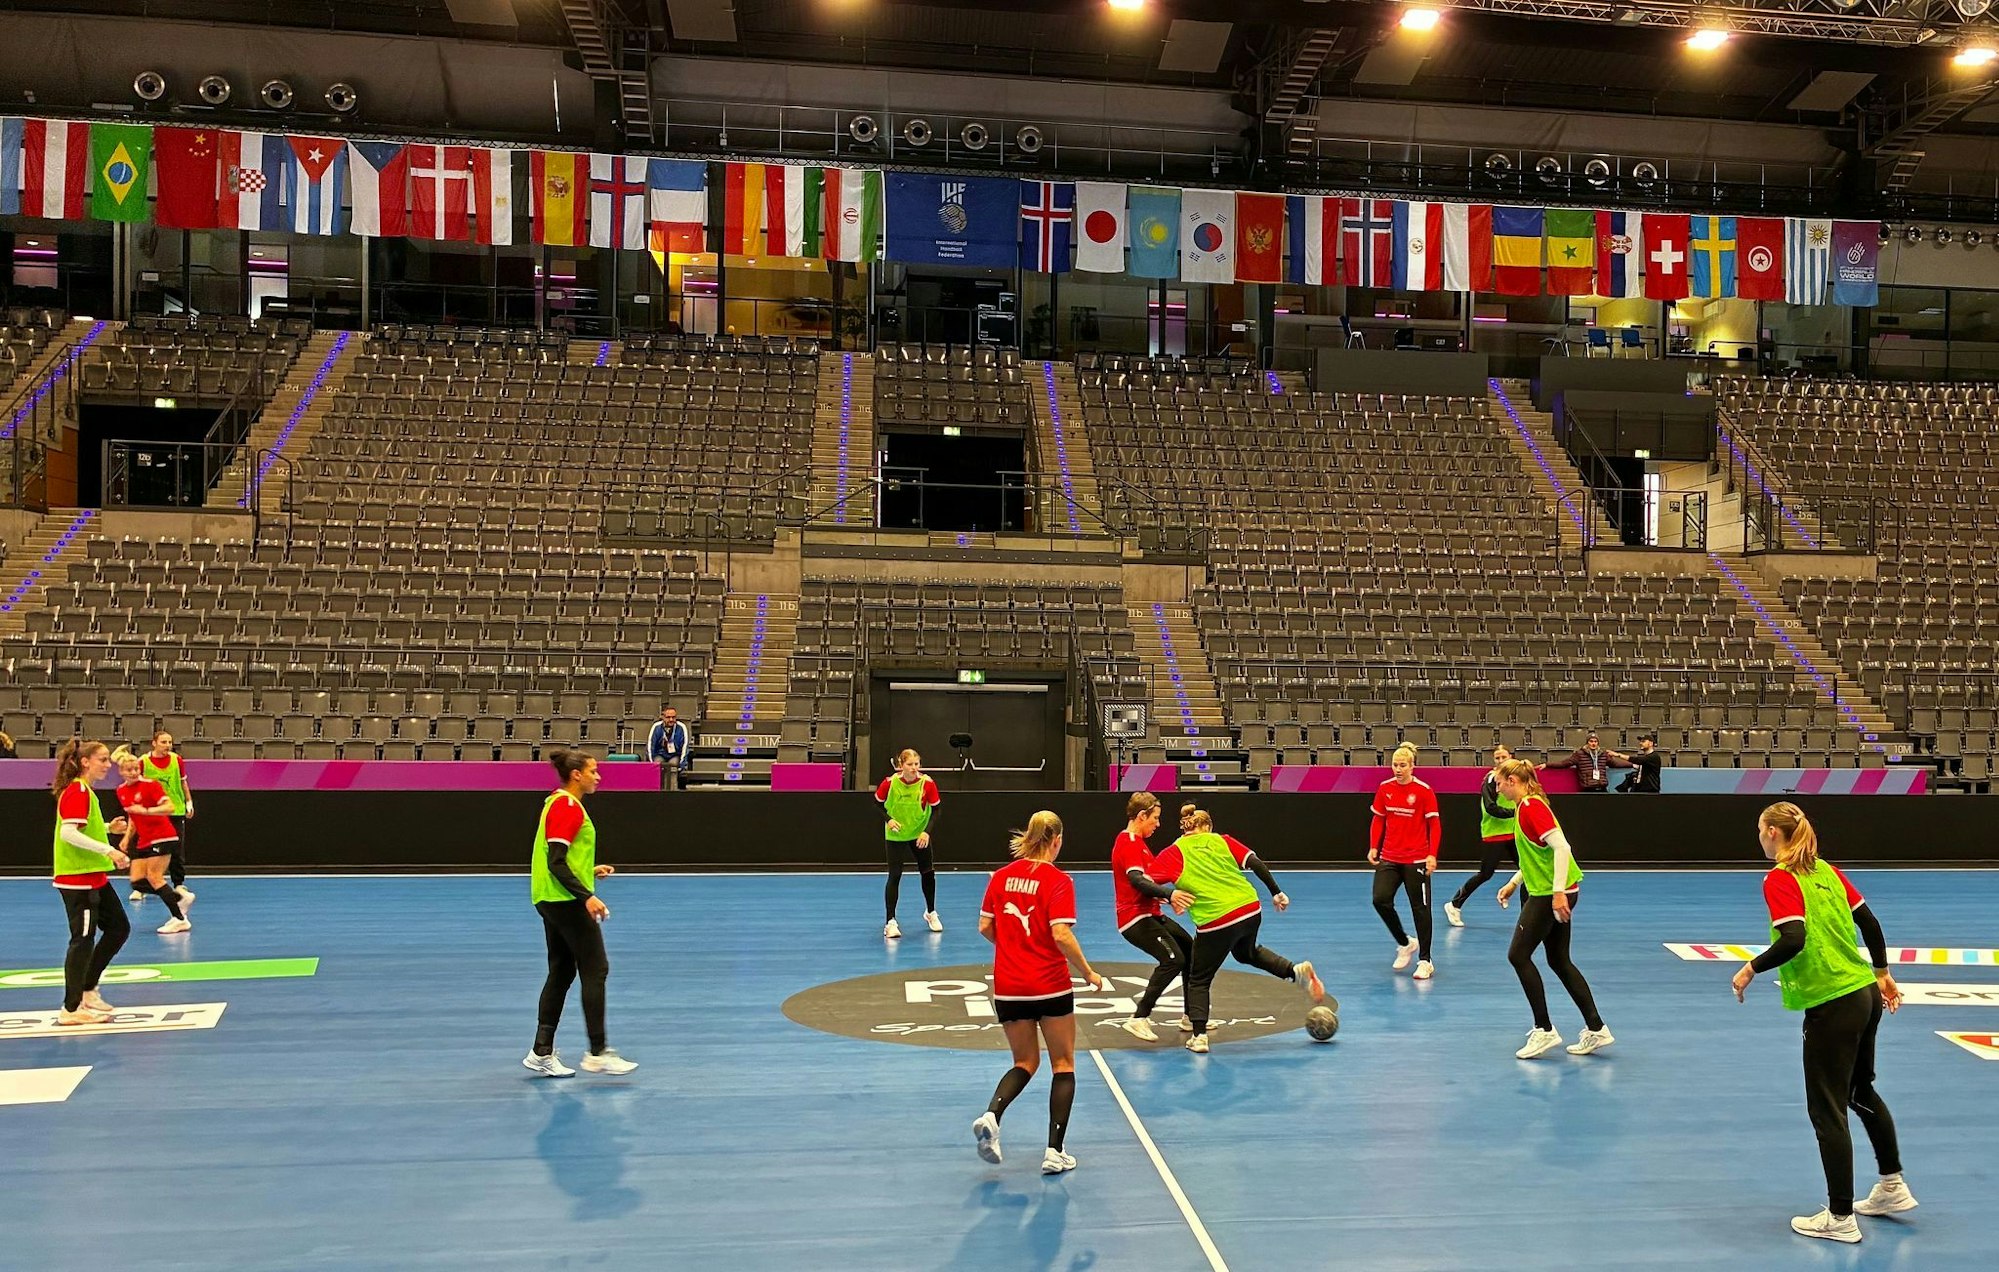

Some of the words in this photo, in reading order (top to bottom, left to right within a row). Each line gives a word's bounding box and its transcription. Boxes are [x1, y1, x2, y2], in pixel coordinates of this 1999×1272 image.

[942, 182, 967, 206] IHF
[701, 736, 722, 746] 11M
[758, 736, 780, 746] 11M
[1211, 740, 1231, 749] 11M
[1894, 745, 1912, 754] 10M
[1004, 876, 1040, 895] GERMANY
